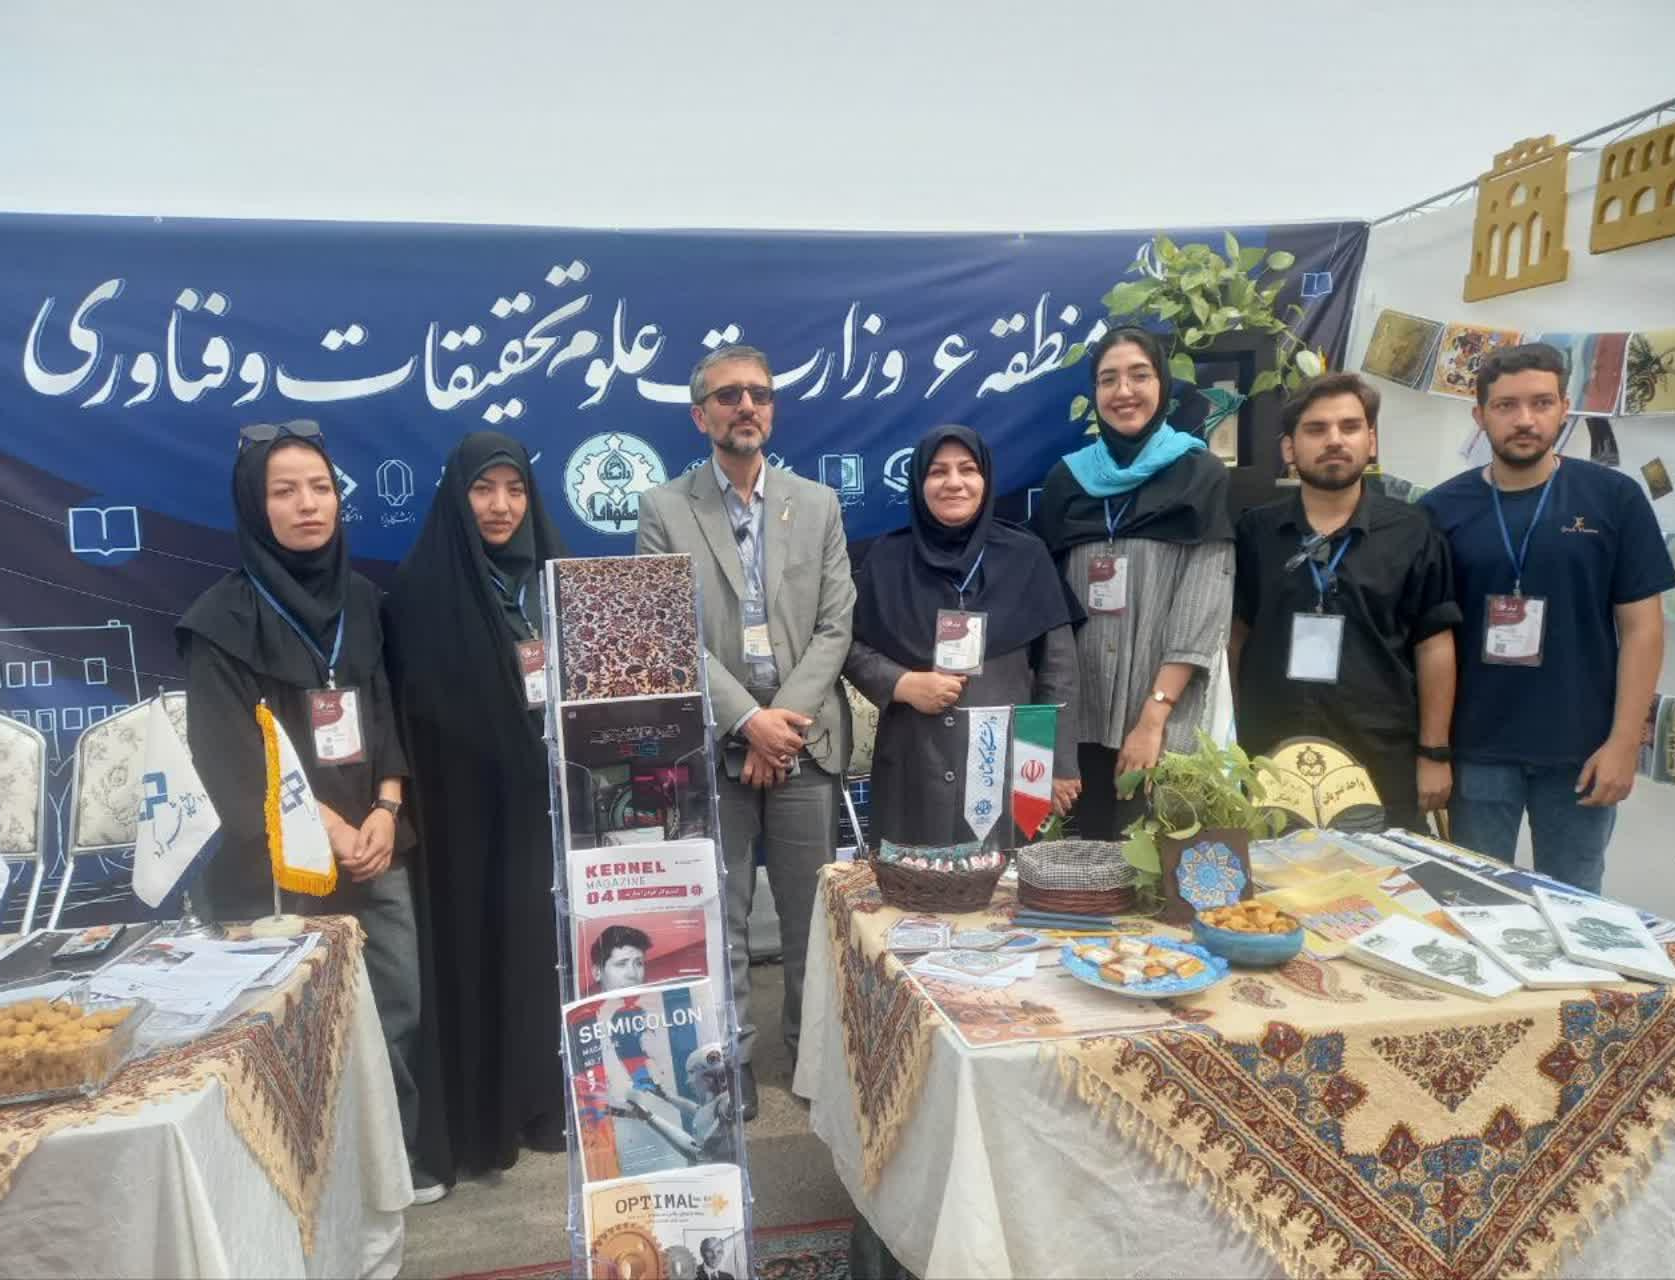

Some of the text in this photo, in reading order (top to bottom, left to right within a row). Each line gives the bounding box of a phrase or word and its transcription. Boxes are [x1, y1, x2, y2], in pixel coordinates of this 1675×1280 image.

[22, 277, 234, 409] فناوری
[276, 258, 593, 425] تحقیقات
[546, 297, 667, 411] علوم
[636, 299, 907, 405] وزارت
[585, 860, 667, 879] KERNEL
[586, 888, 615, 905] 04
[578, 1006, 704, 1044] SEMICOLON
[615, 1193, 699, 1214] OPTIMAL
